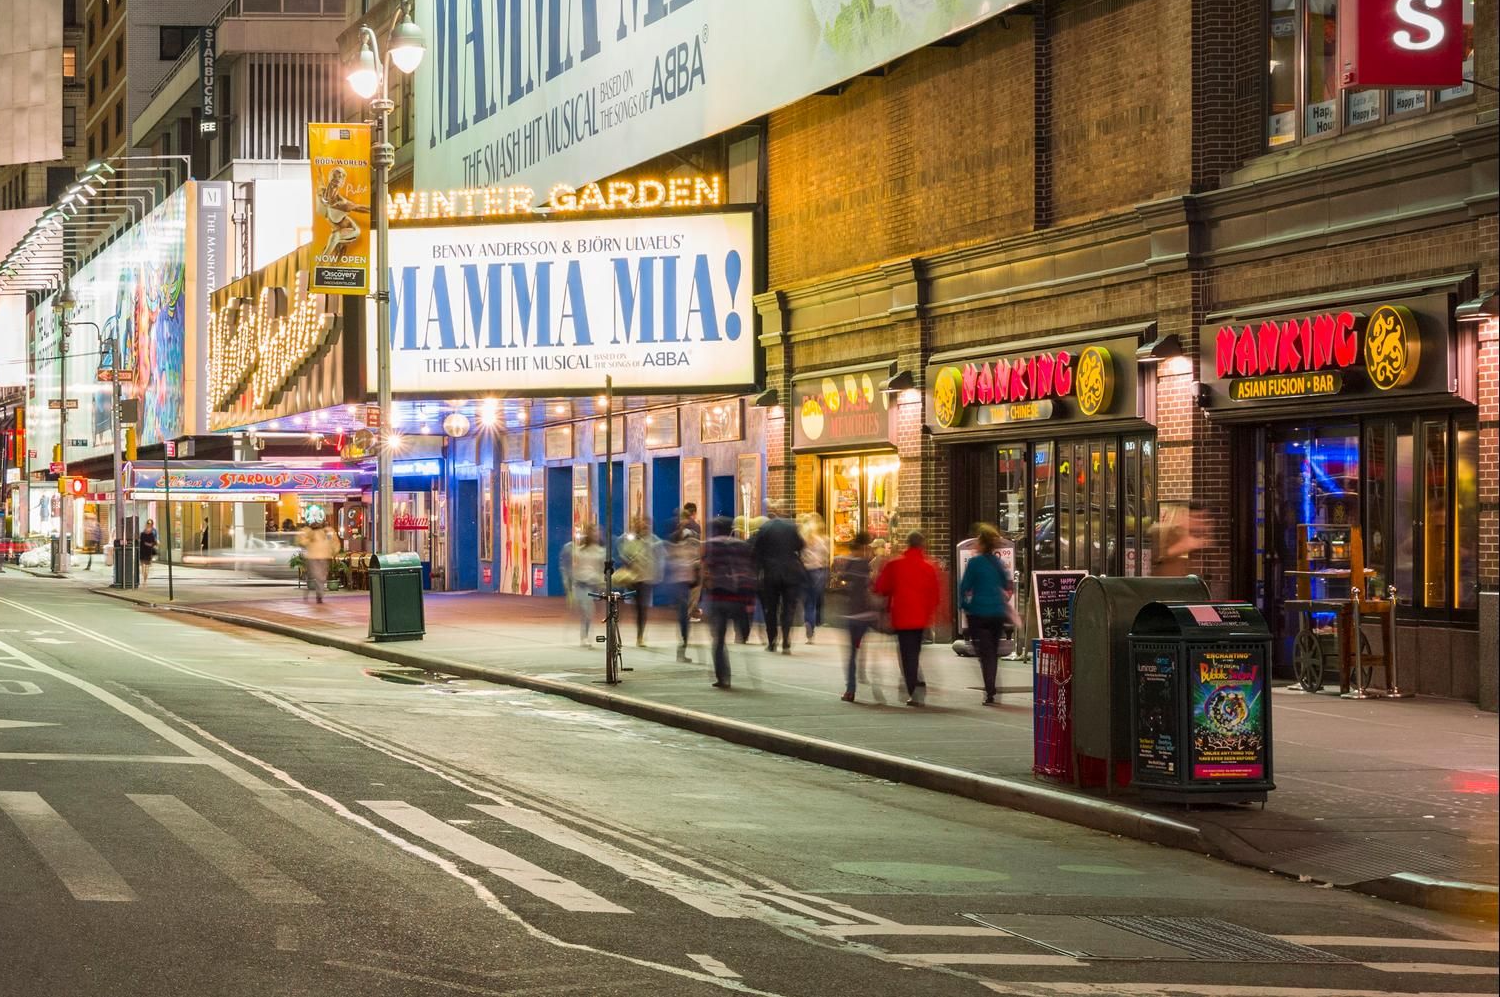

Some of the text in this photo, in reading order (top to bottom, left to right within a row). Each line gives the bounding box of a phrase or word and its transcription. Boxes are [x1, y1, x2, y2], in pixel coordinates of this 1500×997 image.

[203, 28, 214, 115] STARBUCKS
[600, 34, 706, 132] THE SONGS OF ABBA
[600, 68, 634, 104] BASED ON
[463, 86, 599, 189] THE SMASH HIT MUSICAL
[387, 175, 721, 220] WINTER GARDEN
[207, 212, 217, 233] THE
[432, 234, 685, 259] BENNY ANDERSSON & BJÖRN ULVAEUS'
[315, 254, 367, 264] NOW OPEN
[323, 270, 357, 279] Discovery
[389, 249, 742, 351] MAMMA MIA!
[594, 353, 614, 361] BASED
[1215, 310, 1358, 380] NANKING
[425, 354, 593, 373] THE SMASH HIT MUSICAL
[643, 352, 690, 367] ABBA
[962, 350, 1072, 408] NANKING
[1237, 375, 1334, 398] ASIAN FUSION BAR
[1010, 403, 1040, 420] CHINESE
[829, 413, 880, 438] MEMORIES
[218, 472, 290, 489] STARDUST
[292, 473, 351, 489] Diner
[1199, 662, 1228, 683] Bubble
